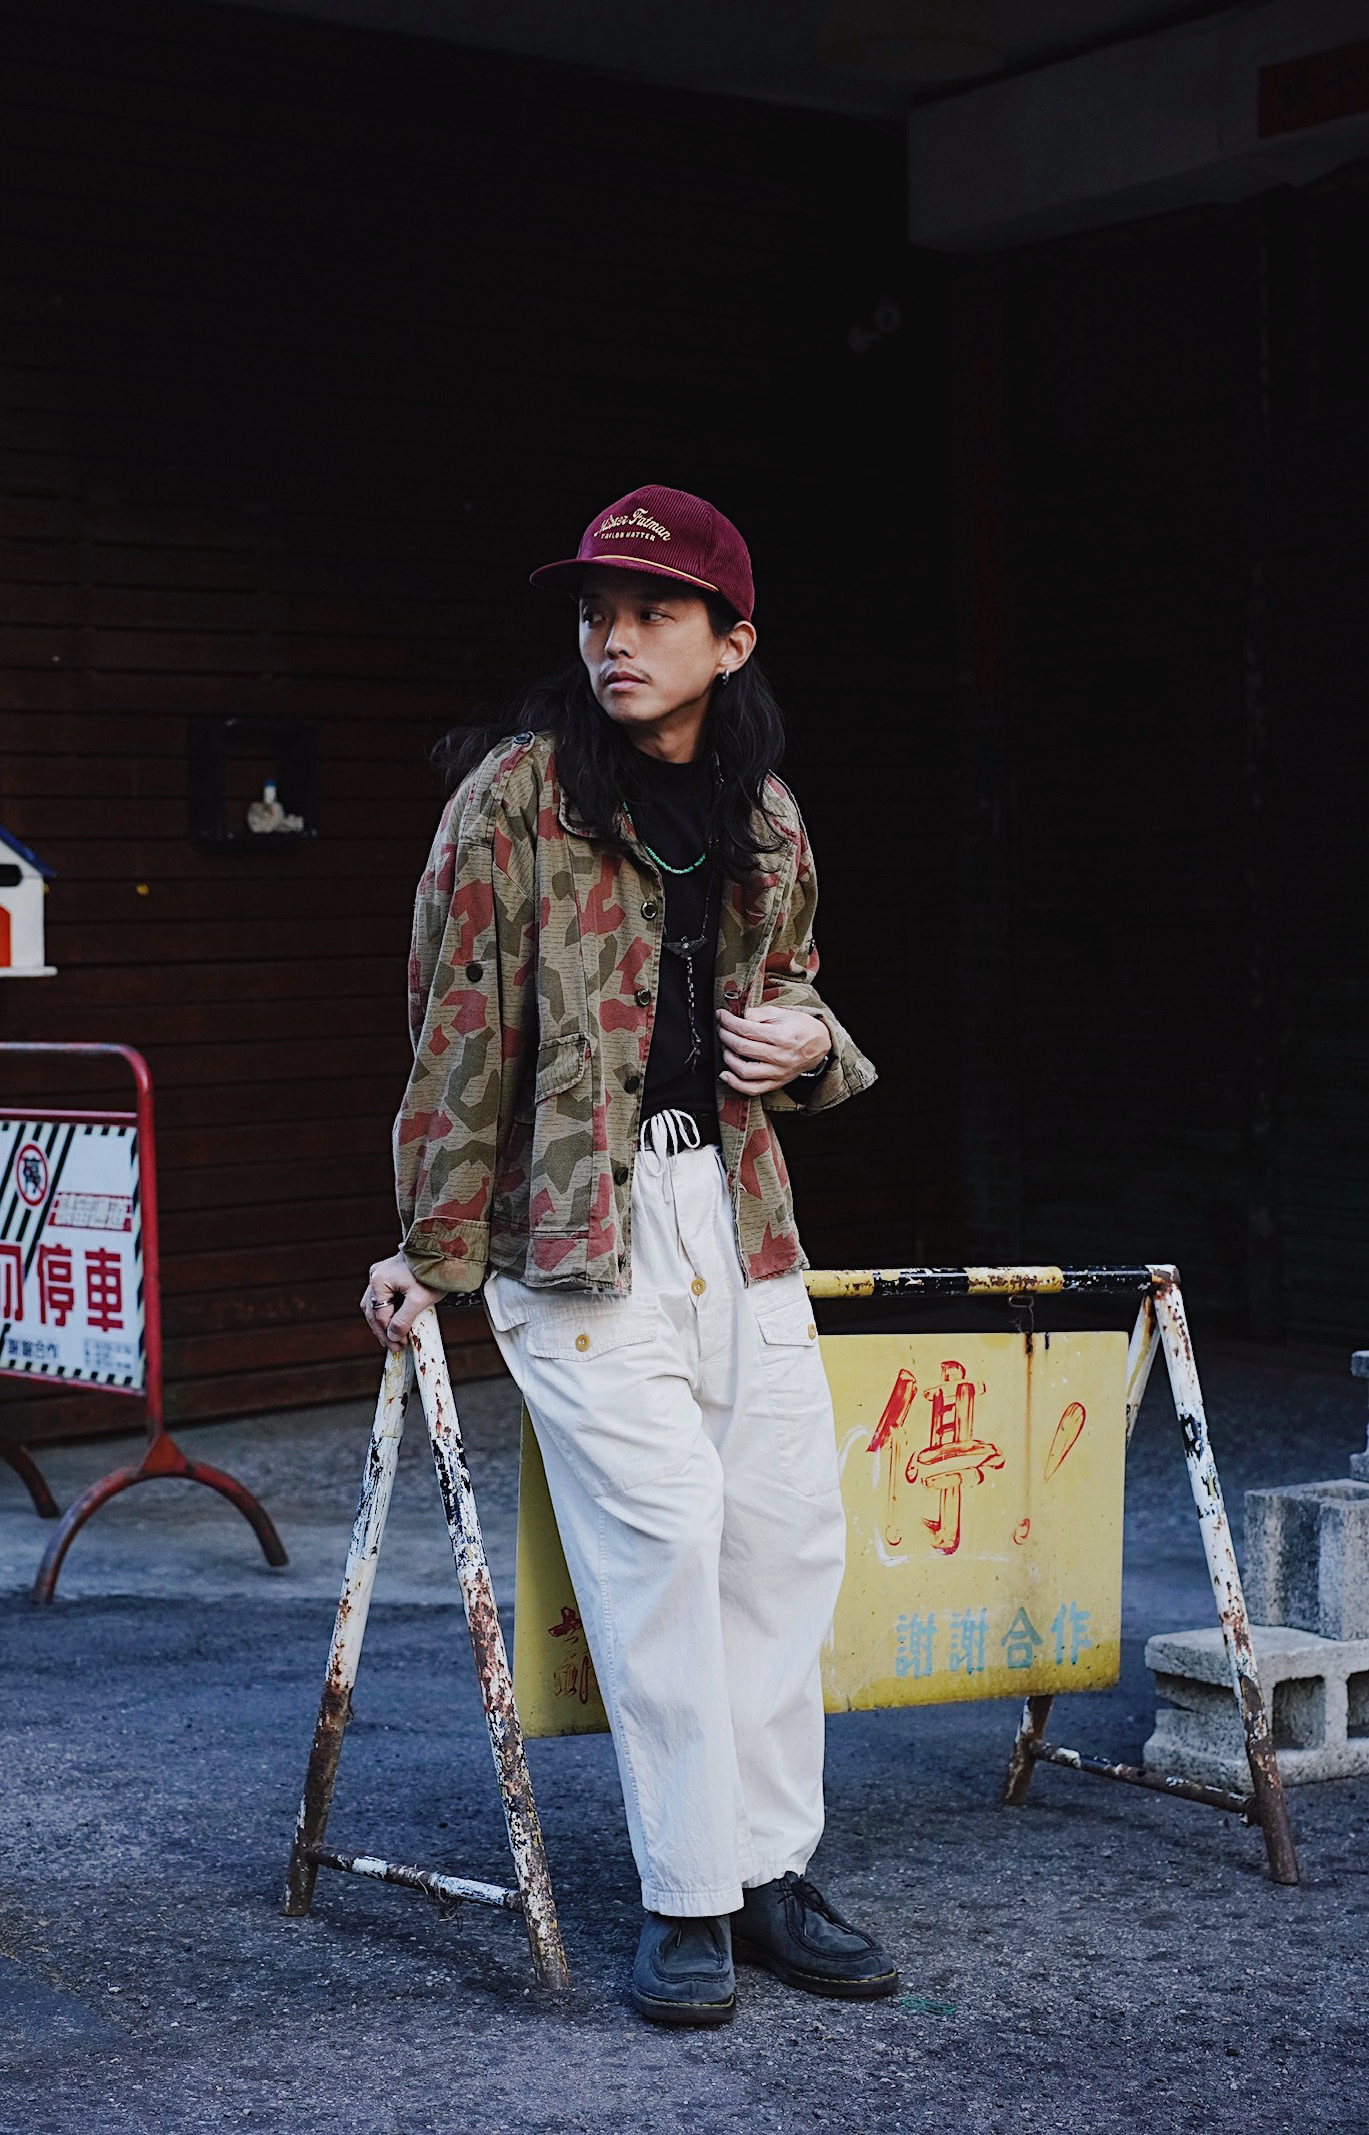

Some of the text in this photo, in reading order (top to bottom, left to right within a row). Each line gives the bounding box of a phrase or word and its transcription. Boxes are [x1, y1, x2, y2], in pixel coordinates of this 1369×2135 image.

[628, 508, 671, 541] Fatman
[895, 1601, 1095, 1680] 謝謝合作
